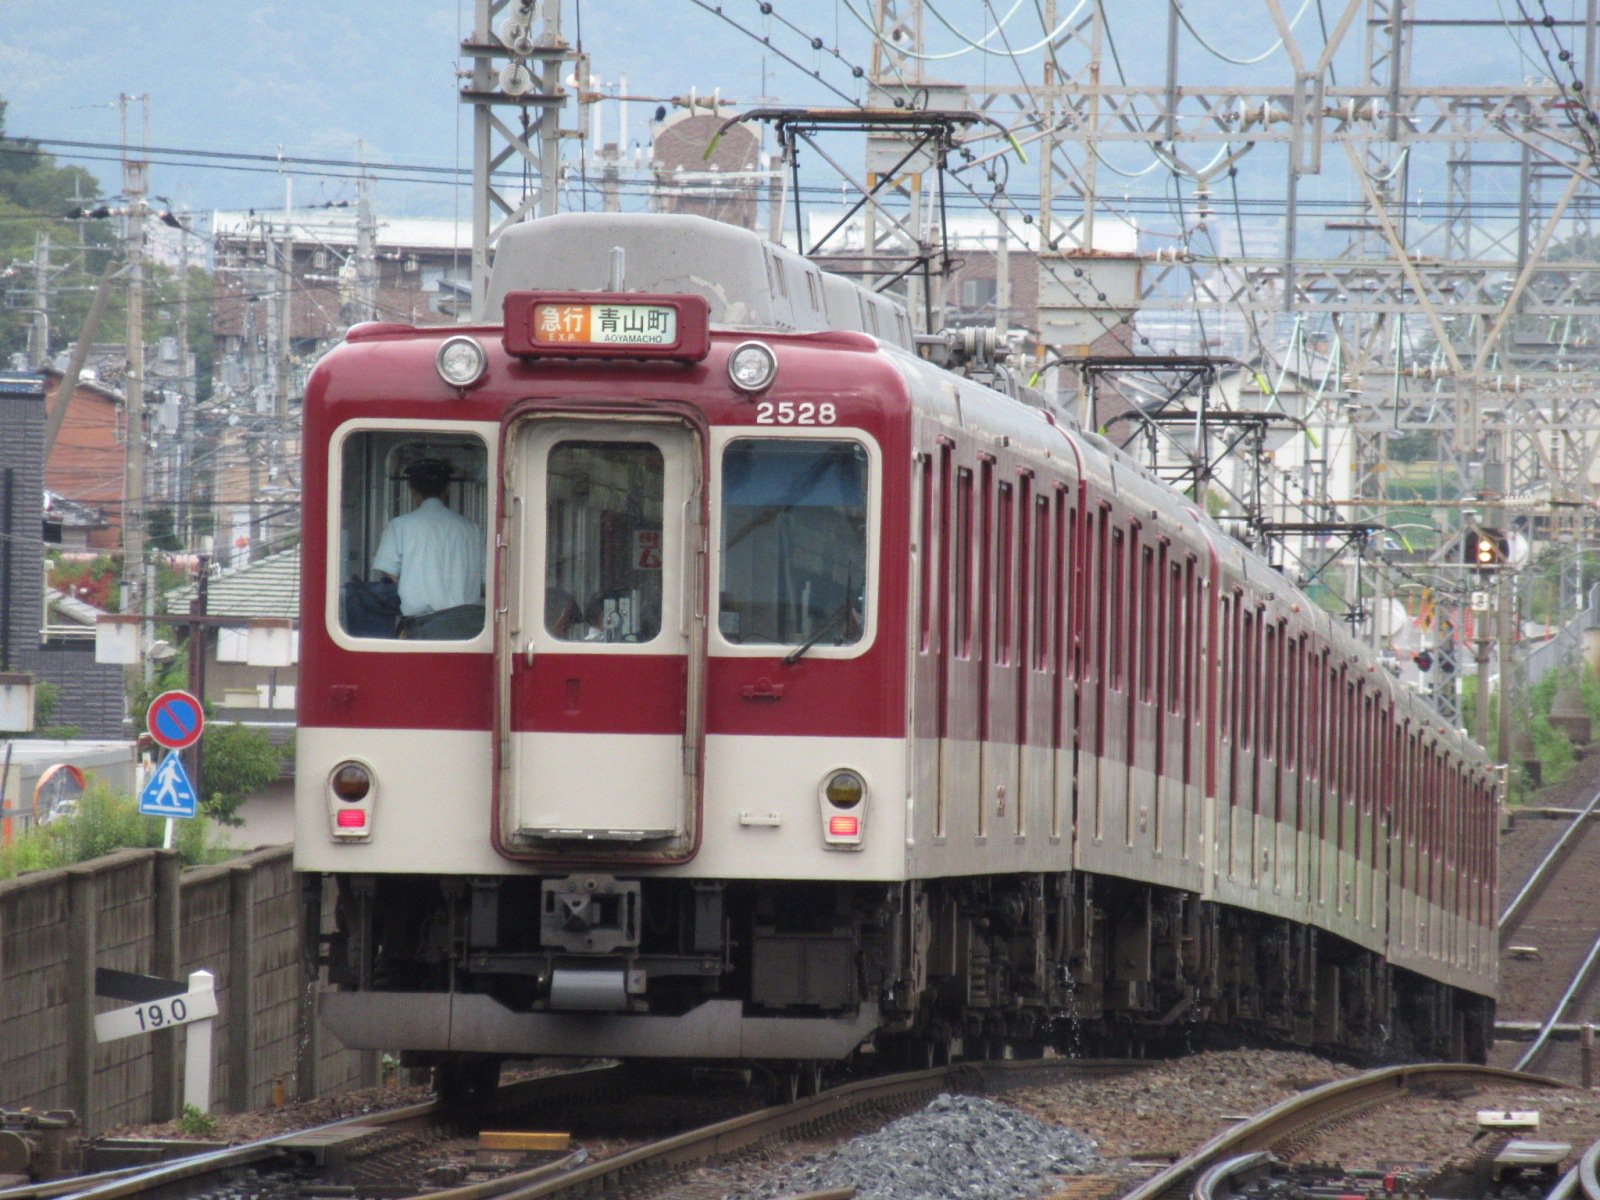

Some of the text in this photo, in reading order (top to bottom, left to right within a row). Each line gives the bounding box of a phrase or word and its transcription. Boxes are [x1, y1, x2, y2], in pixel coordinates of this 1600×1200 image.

[540, 307, 584, 332] 急行
[598, 307, 670, 333] 青山町
[604, 334, 663, 344] AOYAMACHO
[756, 402, 836, 425] 2528
[134, 998, 187, 1031] 19.0
